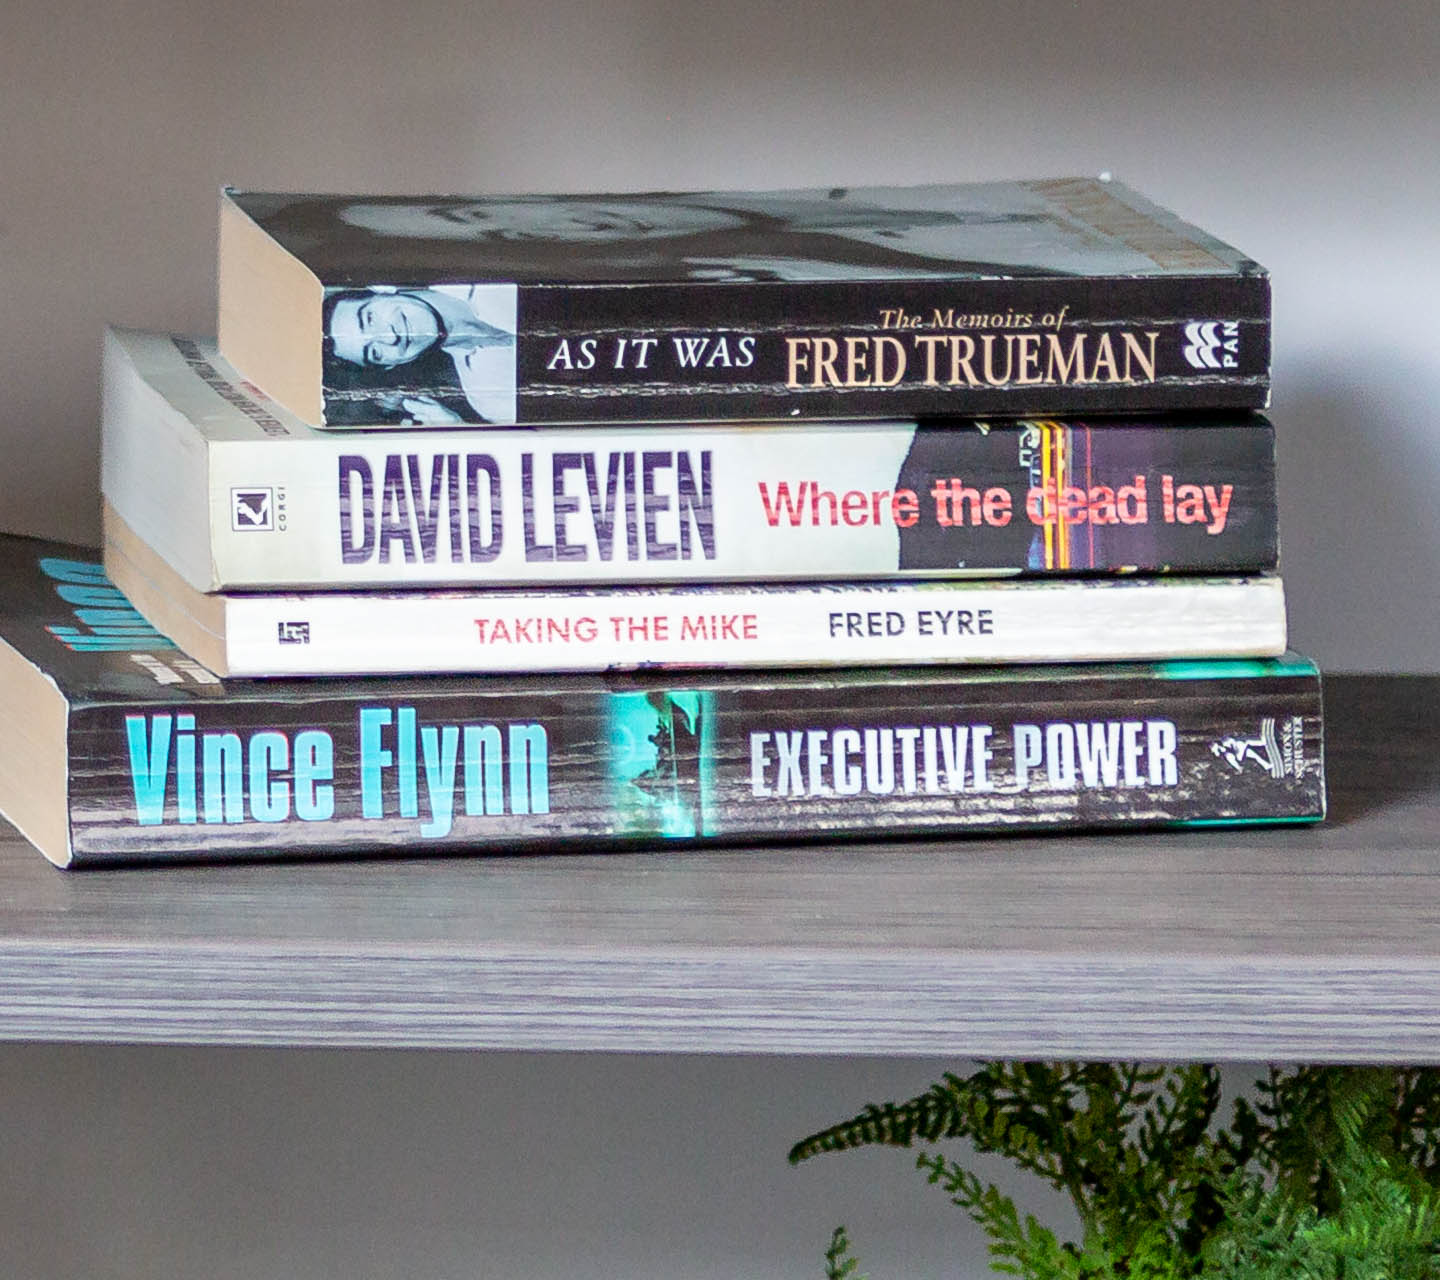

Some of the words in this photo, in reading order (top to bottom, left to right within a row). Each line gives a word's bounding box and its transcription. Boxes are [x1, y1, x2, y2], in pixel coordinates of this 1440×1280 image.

[879, 308, 922, 328] The
[932, 308, 1033, 328] Memoirs
[1042, 306, 1070, 332] of
[547, 339, 596, 369] AS
[615, 339, 657, 368] IT
[673, 337, 755, 367] WAS
[787, 337, 906, 388] FRED
[915, 333, 1159, 385] TRUEMAN
[1223, 321, 1239, 368] PAN
[278, 487, 286, 531] CORGI
[339, 454, 503, 563] DAVID
[521, 451, 715, 561] LEVIEN
[758, 481, 918, 528] Where
[931, 479, 1012, 526] the
[1026, 476, 1146, 526] dead
[1162, 475, 1233, 534] lay
[474, 617, 597, 643] TAKING
[610, 616, 668, 640] THE
[681, 615, 757, 640] MIKE
[829, 612, 904, 637] FRED
[918, 610, 993, 635] EYRE
[126, 715, 333, 825] Vince
[359, 708, 549, 838] Flynn
[751, 724, 994, 796] EXECUTIVE
[1012, 721, 1178, 786] POWER
